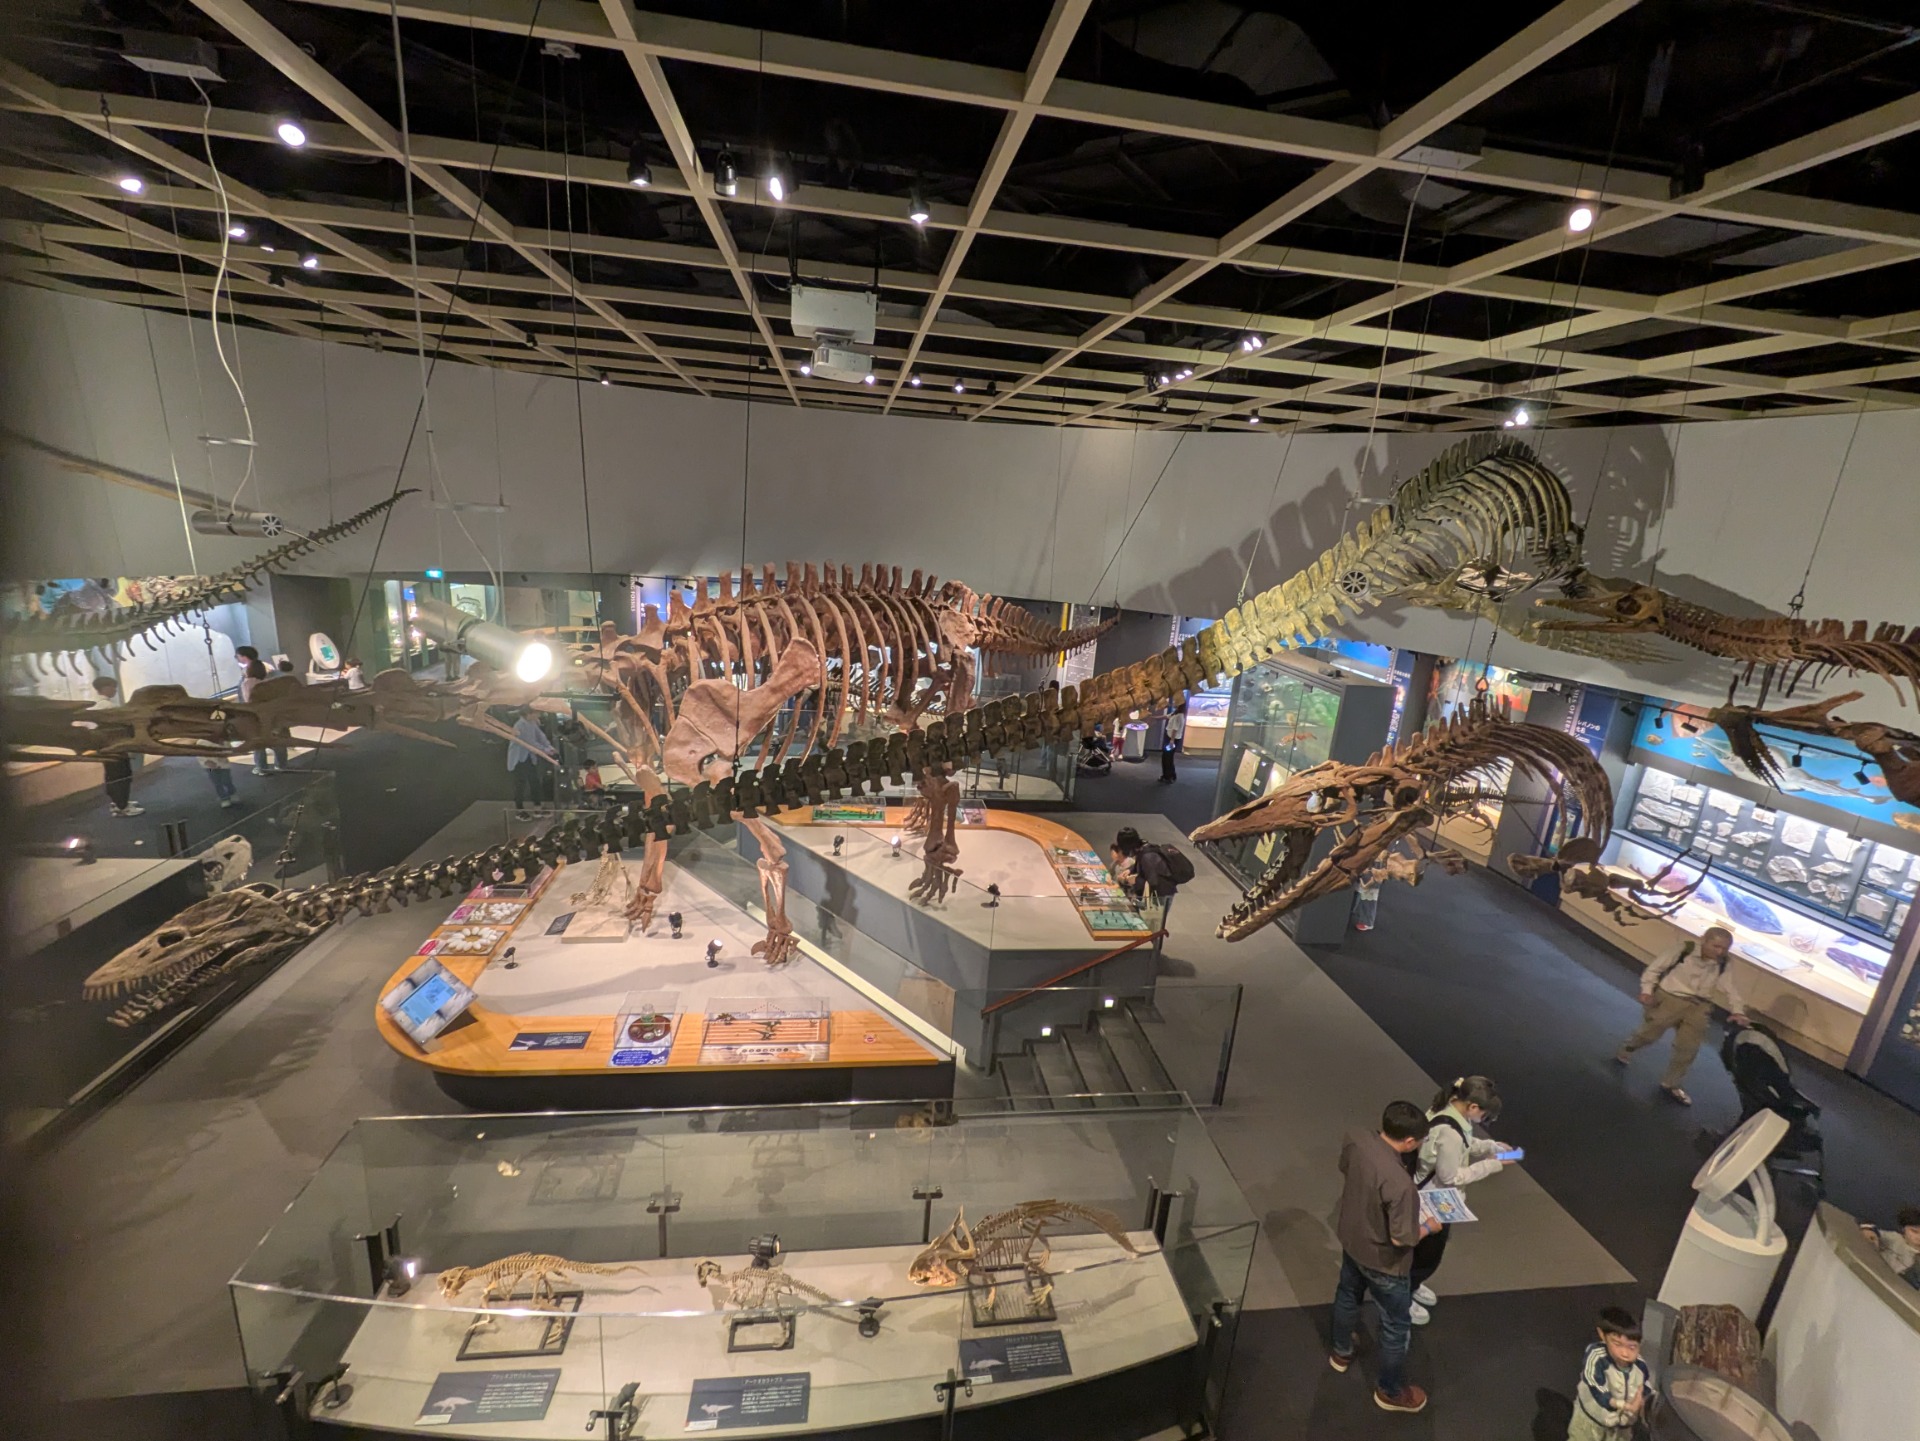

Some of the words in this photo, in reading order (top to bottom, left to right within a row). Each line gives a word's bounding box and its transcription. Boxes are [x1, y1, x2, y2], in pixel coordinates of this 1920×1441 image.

[1577, 720, 1601, 731] レバノンの
